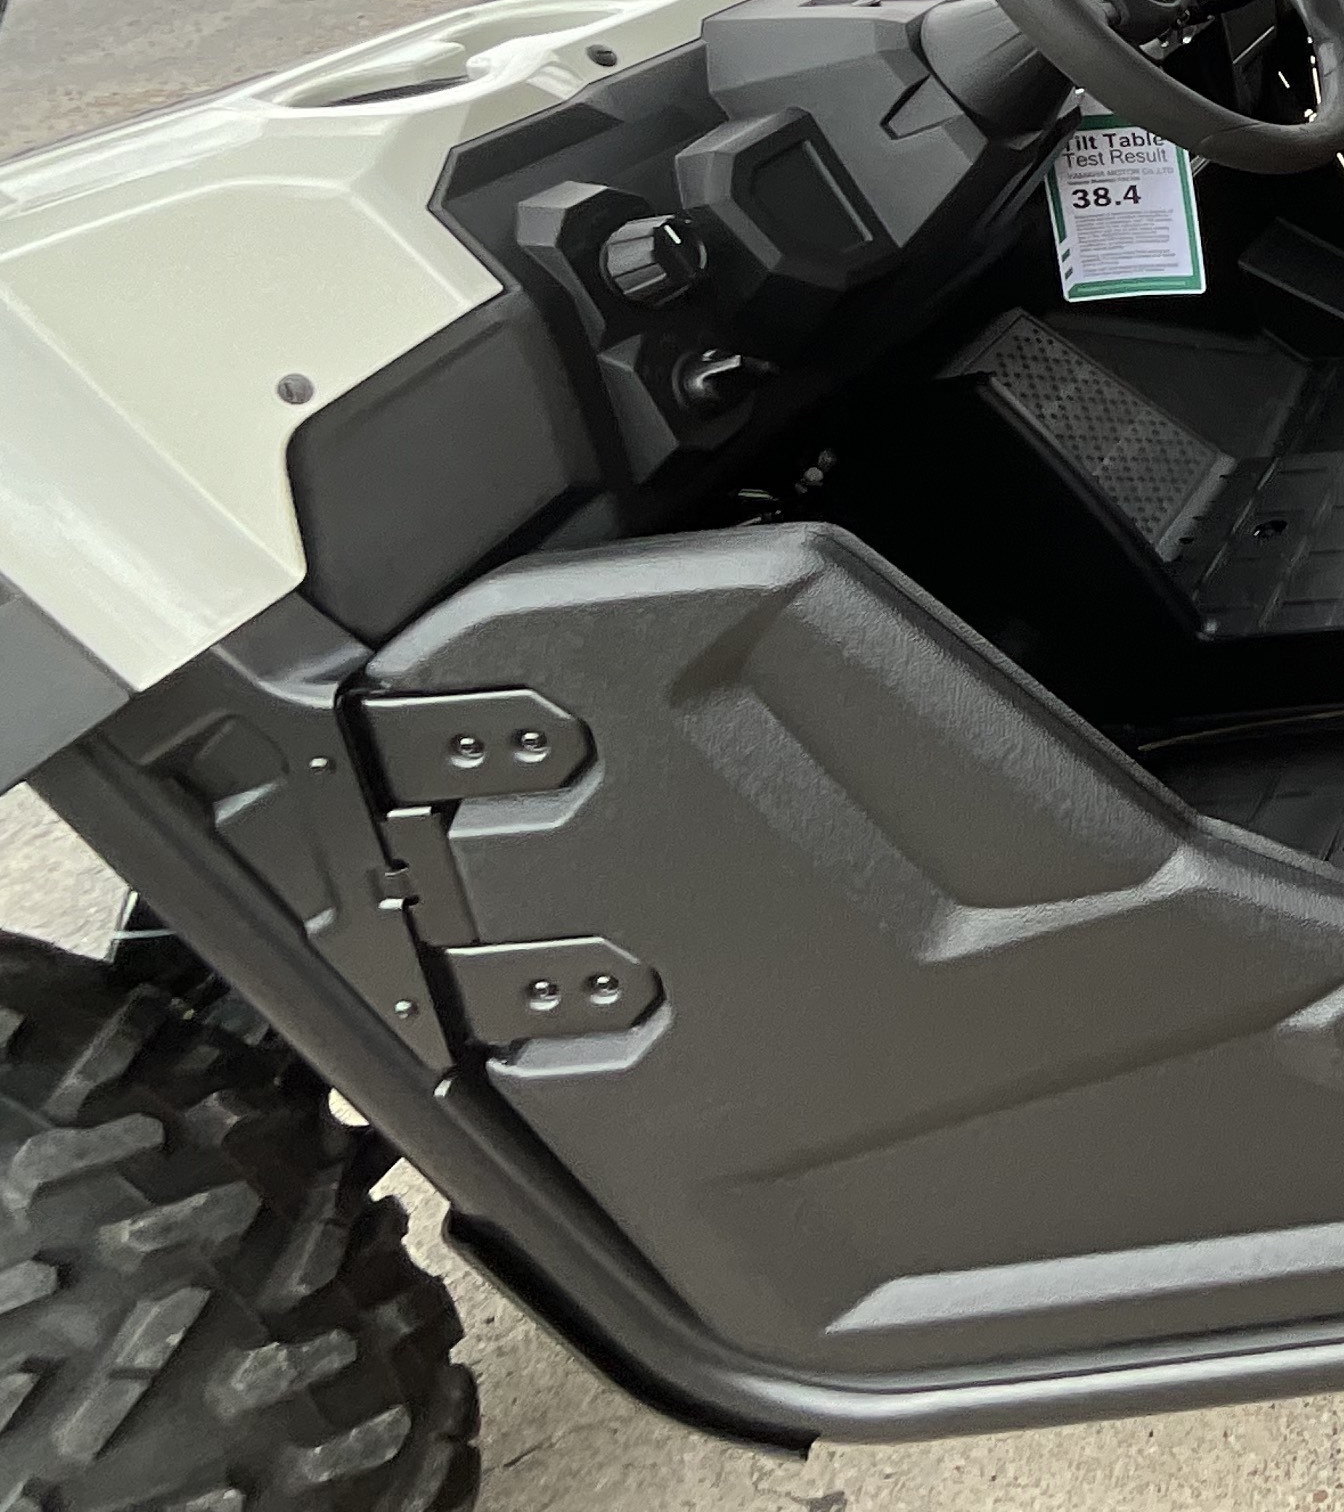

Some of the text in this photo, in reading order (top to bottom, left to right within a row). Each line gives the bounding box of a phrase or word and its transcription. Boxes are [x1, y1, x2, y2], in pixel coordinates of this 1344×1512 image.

[1102, 131, 1165, 148] Table
[1062, 148, 1168, 168] Test Result
[1072, 184, 1141, 209] 38.4
